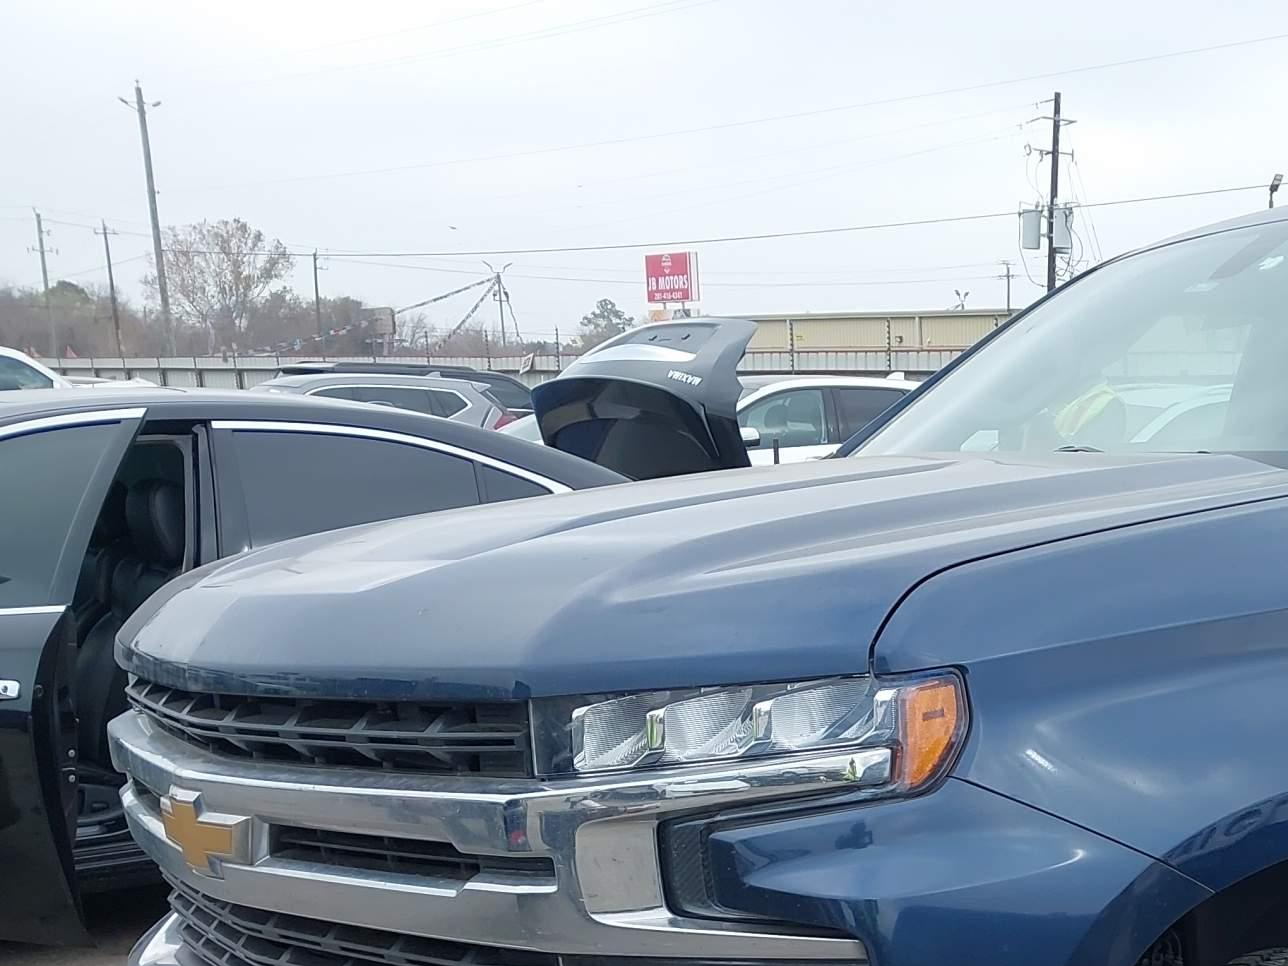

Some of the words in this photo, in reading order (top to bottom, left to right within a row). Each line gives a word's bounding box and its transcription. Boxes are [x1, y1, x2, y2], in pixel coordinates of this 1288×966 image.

[648, 276, 657, 291] JB
[658, 274, 688, 290] MOTORS
[667, 369, 703, 387] MAXIMA
